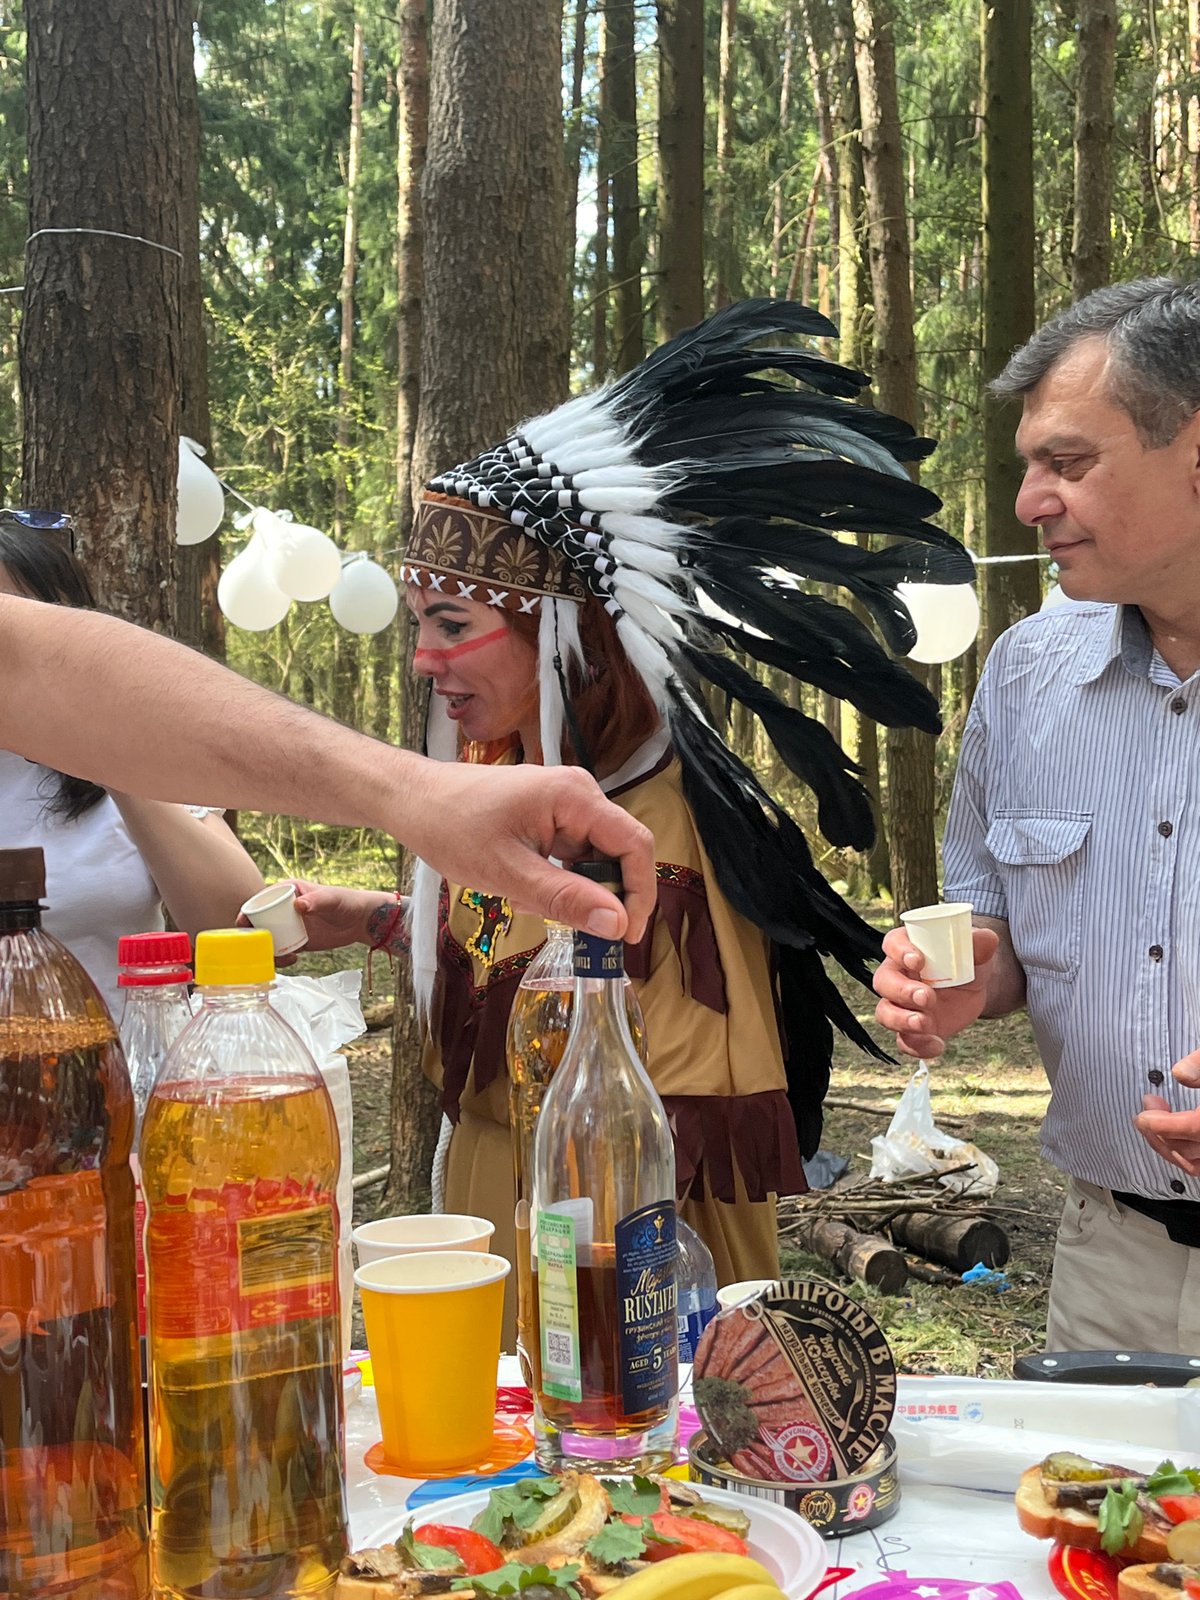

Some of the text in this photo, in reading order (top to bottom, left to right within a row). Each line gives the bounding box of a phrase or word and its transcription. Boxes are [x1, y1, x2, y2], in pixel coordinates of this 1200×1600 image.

[766, 1279, 879, 1341] ШПРОТЫ
[629, 1358, 648, 1370] AGED
[652, 1347, 662, 1369] 5
[780, 1322, 840, 1424] натуральное копчение
[820, 1332, 852, 1387] Вкусные
[868, 1344, 891, 1366] В
[781, 1427, 812, 1442] ВКУСНЫЕ
[847, 1374, 896, 1463] МАСЛЕ
